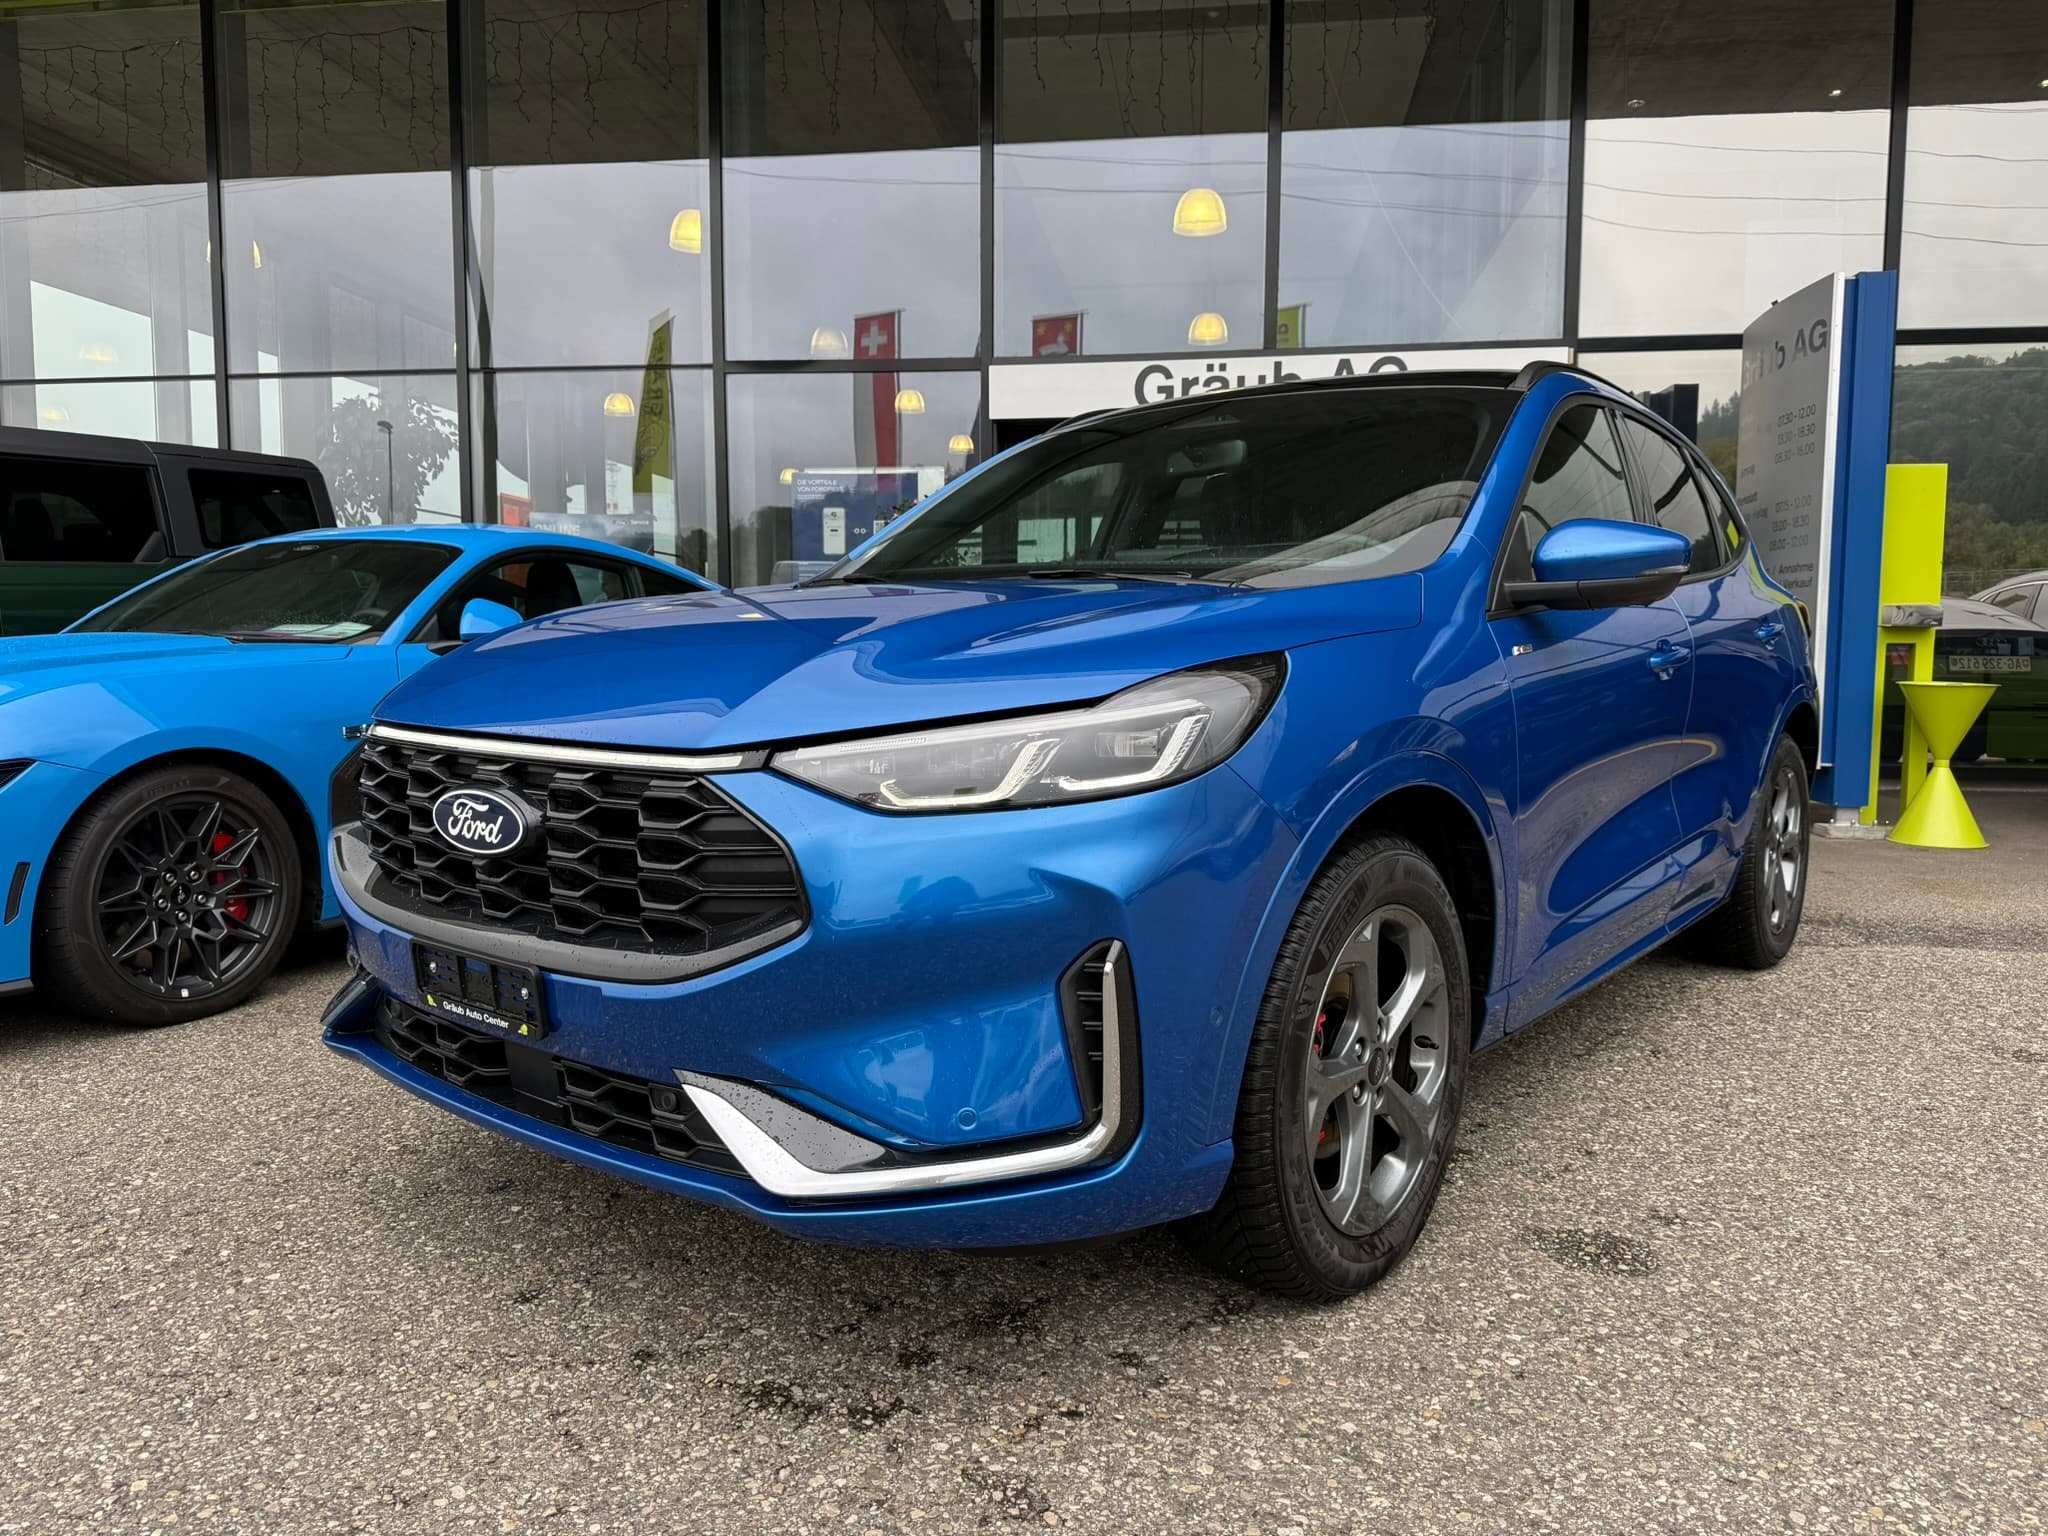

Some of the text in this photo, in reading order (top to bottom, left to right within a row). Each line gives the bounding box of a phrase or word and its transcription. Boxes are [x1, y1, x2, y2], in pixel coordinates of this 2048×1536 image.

[1793, 318, 1828, 362] AG
[448, 798, 504, 845] Ford
[466, 1008, 483, 1021] Auto
[483, 1014, 509, 1029] Center
